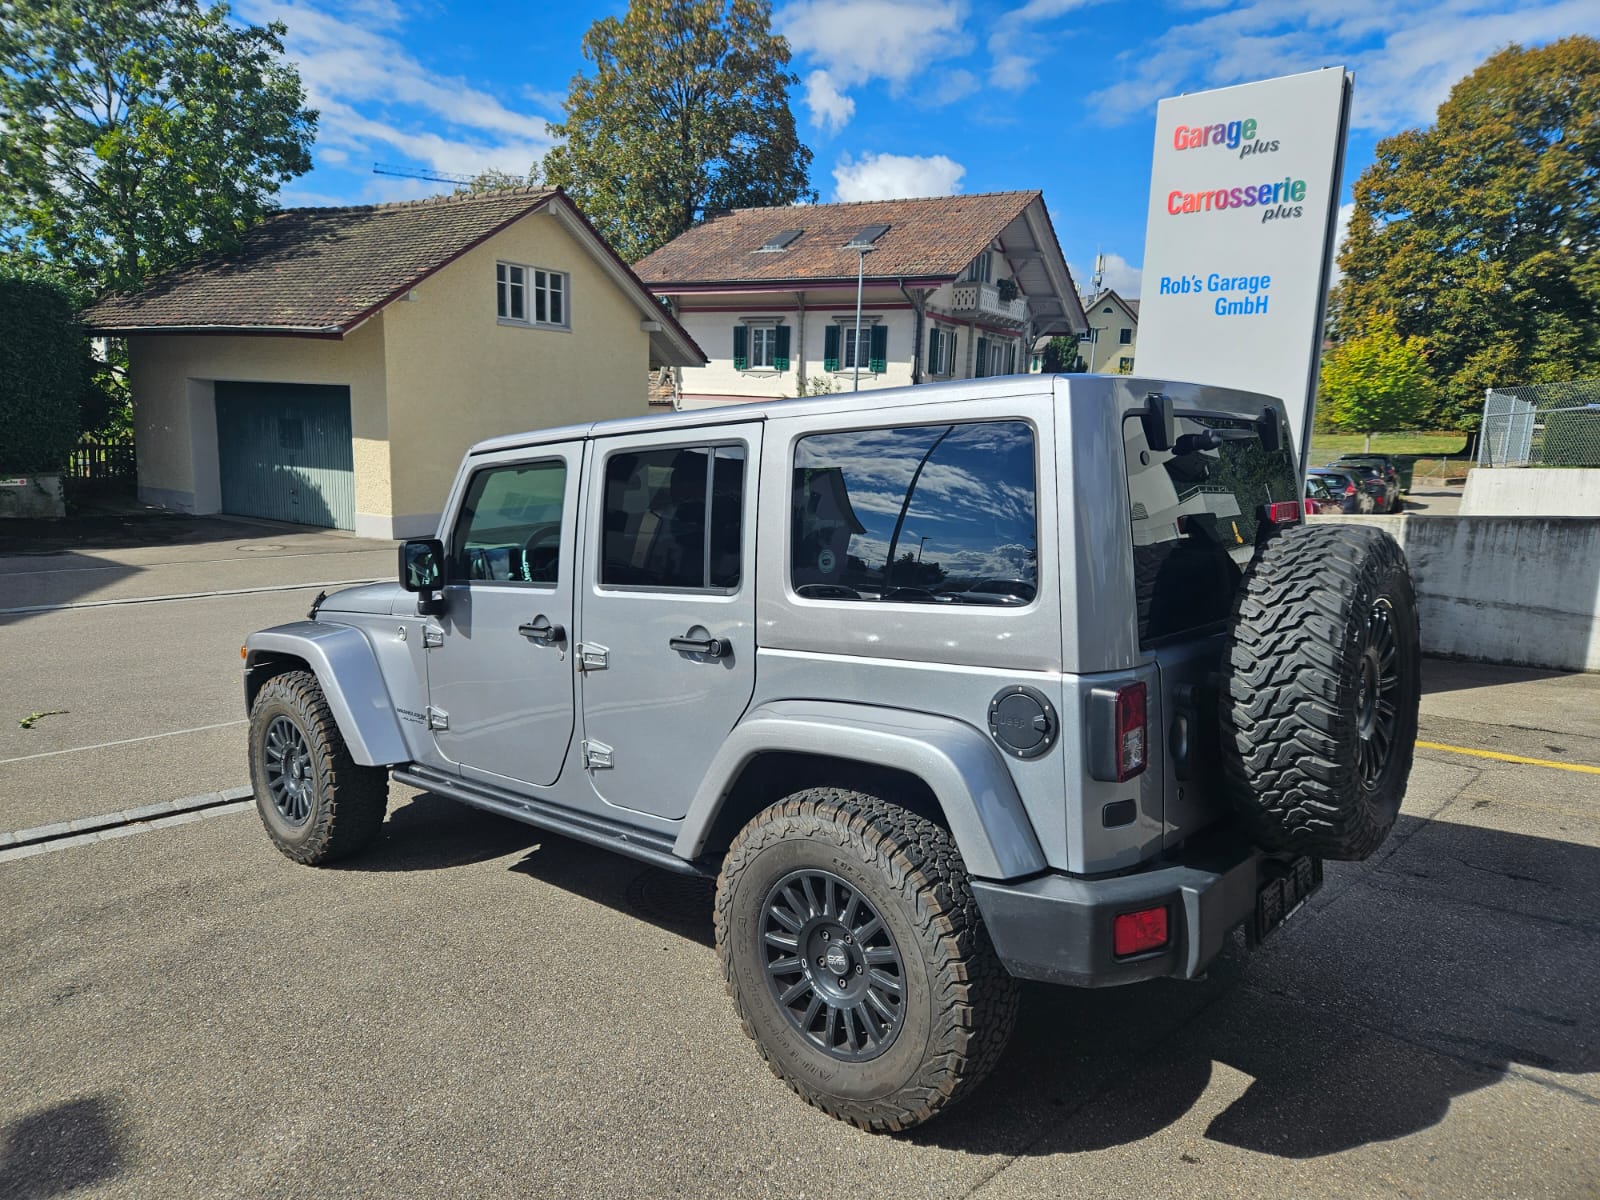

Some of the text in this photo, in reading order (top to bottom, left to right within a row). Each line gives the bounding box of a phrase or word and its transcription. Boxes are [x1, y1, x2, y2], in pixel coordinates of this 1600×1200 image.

[1173, 118, 1258, 151] Garage
[1239, 139, 1281, 160] plus
[1167, 177, 1307, 216] Carrosserie
[1261, 204, 1304, 225] plus
[1207, 273, 1272, 295] Garage
[1214, 295, 1269, 316] GmbH
